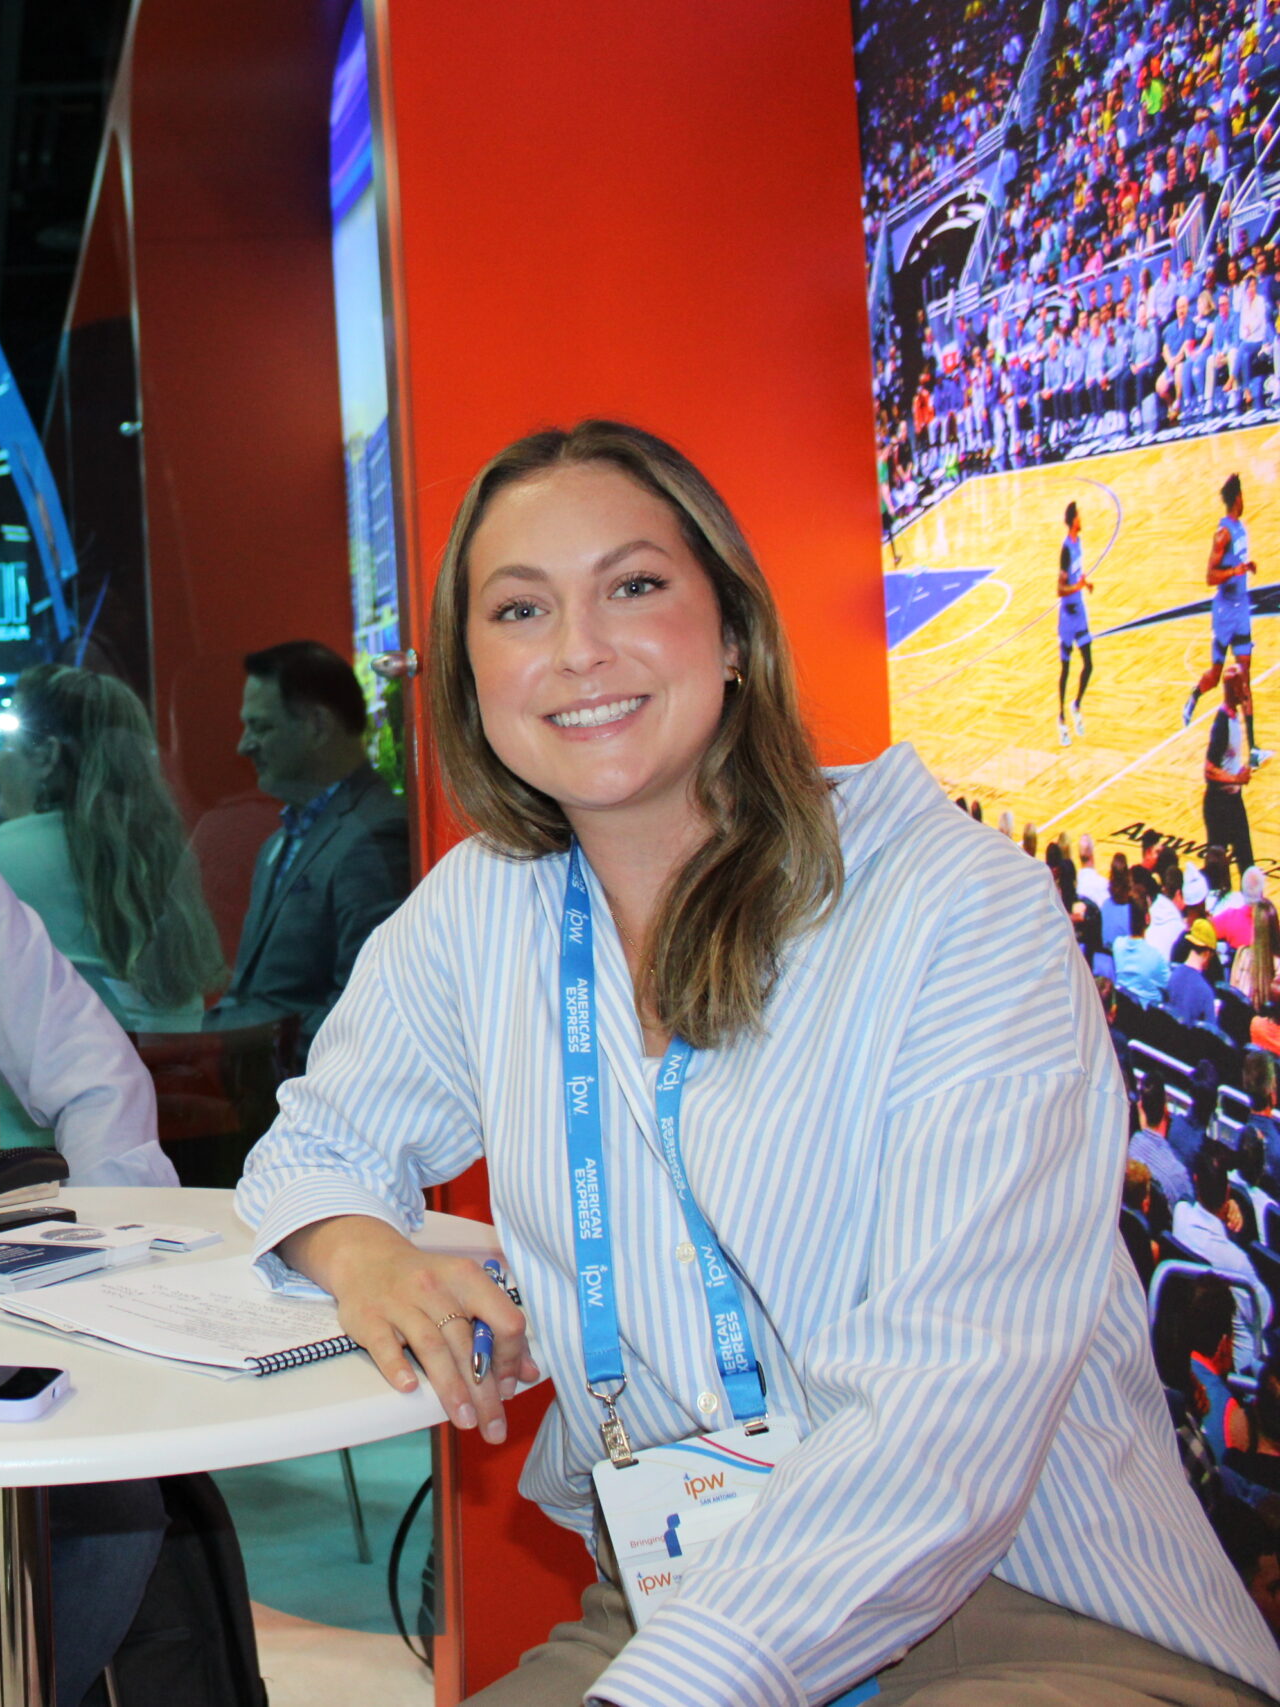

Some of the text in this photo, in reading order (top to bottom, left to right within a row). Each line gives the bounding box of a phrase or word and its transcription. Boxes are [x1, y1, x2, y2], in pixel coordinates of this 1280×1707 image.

[566, 908, 590, 945] ipw
[566, 986, 579, 1053] EXPRESS
[576, 977, 591, 1053] AMERICAN
[566, 1075, 595, 1115] ipw
[656, 1054, 683, 1092] ipw
[574, 1167, 592, 1240] EXPRESS
[584, 1157, 604, 1240] AMERICAN
[580, 1264, 608, 1308] ipw
[701, 1244, 729, 1288] ipw
[683, 1472, 725, 1500] ipw
[637, 1571, 671, 1596] ipw
